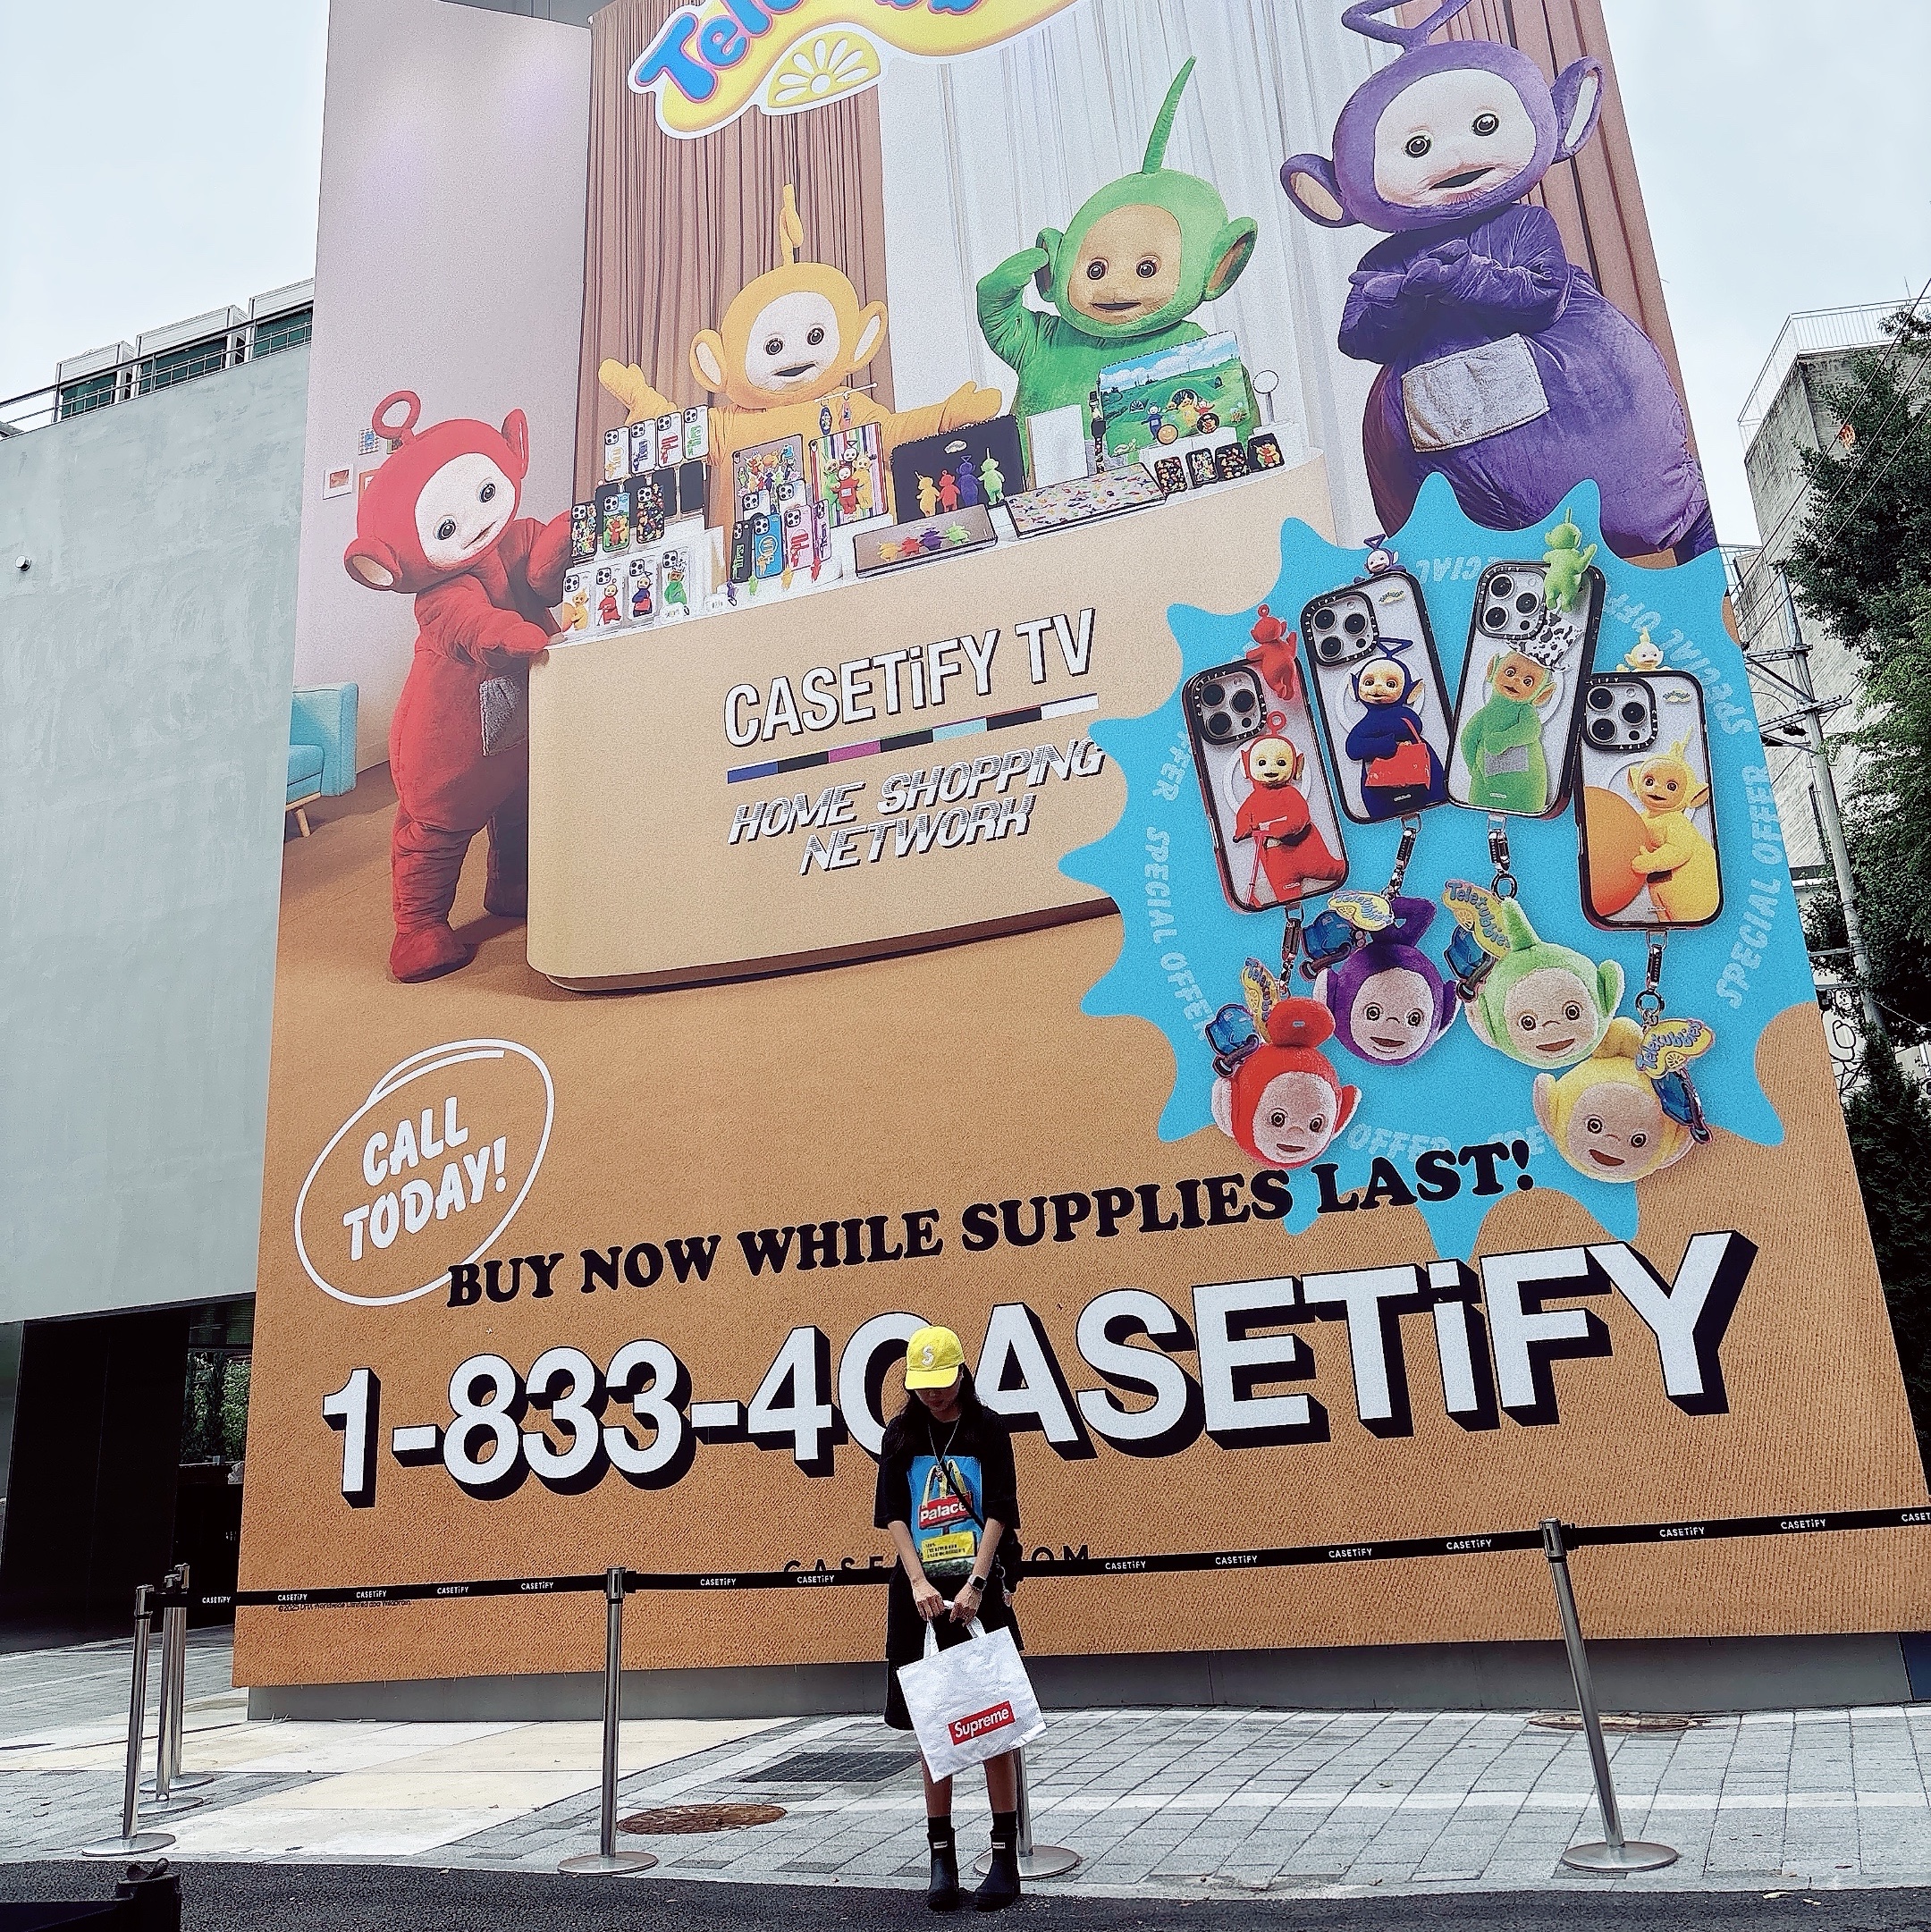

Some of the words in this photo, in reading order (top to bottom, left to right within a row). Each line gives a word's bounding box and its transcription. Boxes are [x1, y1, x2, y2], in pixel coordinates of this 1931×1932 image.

[1416, 555, 1502, 584] CIAL
[1015, 607, 1095, 684] TV
[727, 780, 865, 844] HOME
[878, 737, 1106, 815] SHOPPING
[799, 792, 1037, 875] NETWORK
[1742, 765, 1783, 865] OFFER
[1145, 827, 1177, 944] SPECIAL
[1716, 879, 1782, 1009] SPECIAL
[362, 1096, 468, 1186] CALL
[342, 1135, 507, 1261] TODAY!
[447, 1253, 564, 1307] BUY
[579, 1234, 721, 1295] NOW
[737, 1208, 943, 1277] WHILE
[961, 1168, 1293, 1252] SUPPLIES
[1310, 1140, 1536, 1214] LAST!
[922, 1346, 933, 1366] S
[954, 1708, 1009, 1737] Supreme
